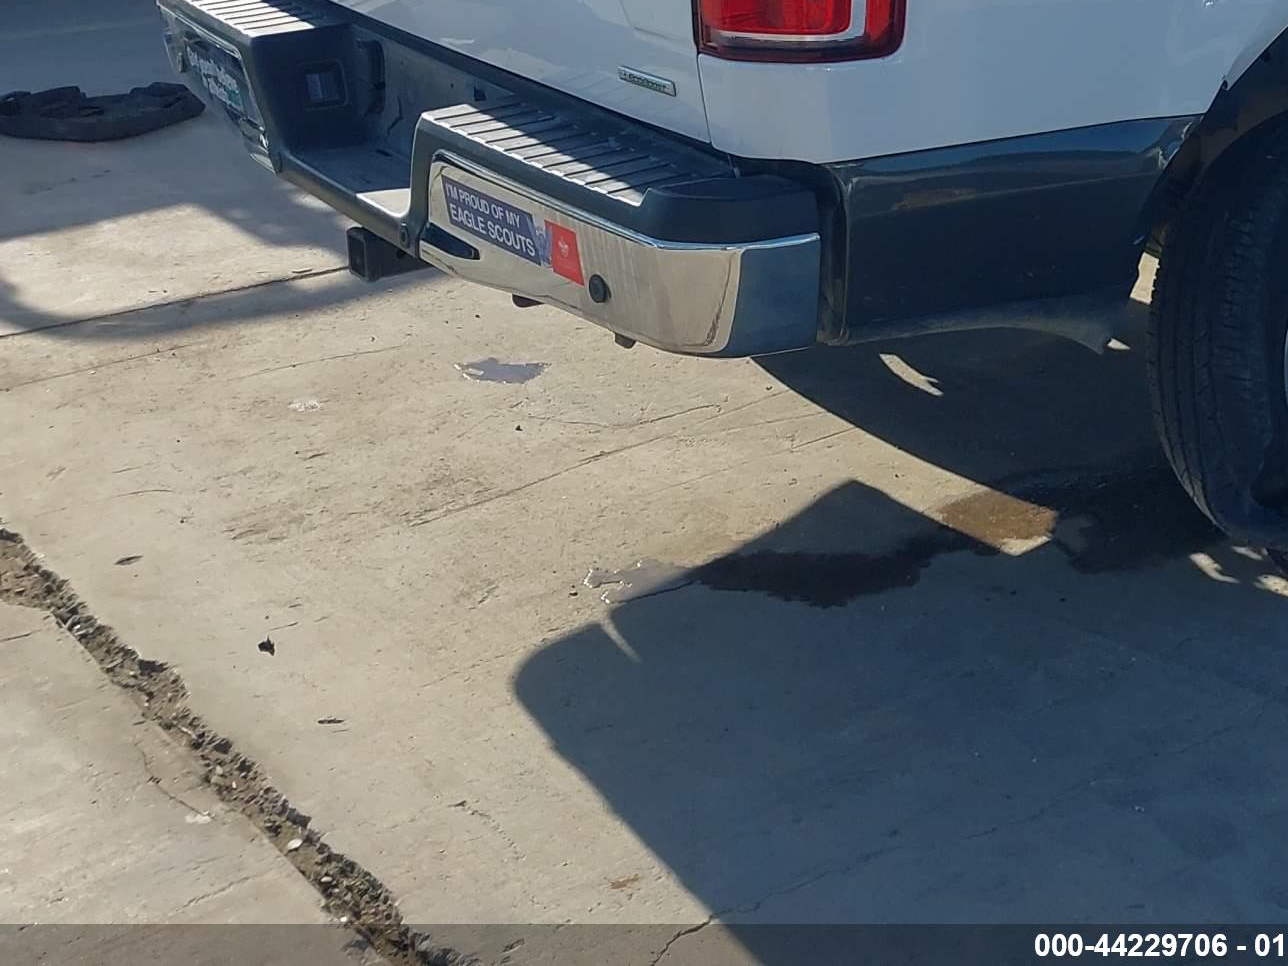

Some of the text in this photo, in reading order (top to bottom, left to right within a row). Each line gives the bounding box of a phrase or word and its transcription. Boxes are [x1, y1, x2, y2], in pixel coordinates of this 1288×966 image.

[445, 183, 521, 228] I'M PROUD OF MY
[450, 203, 536, 257] EAGLE SCOUTS
